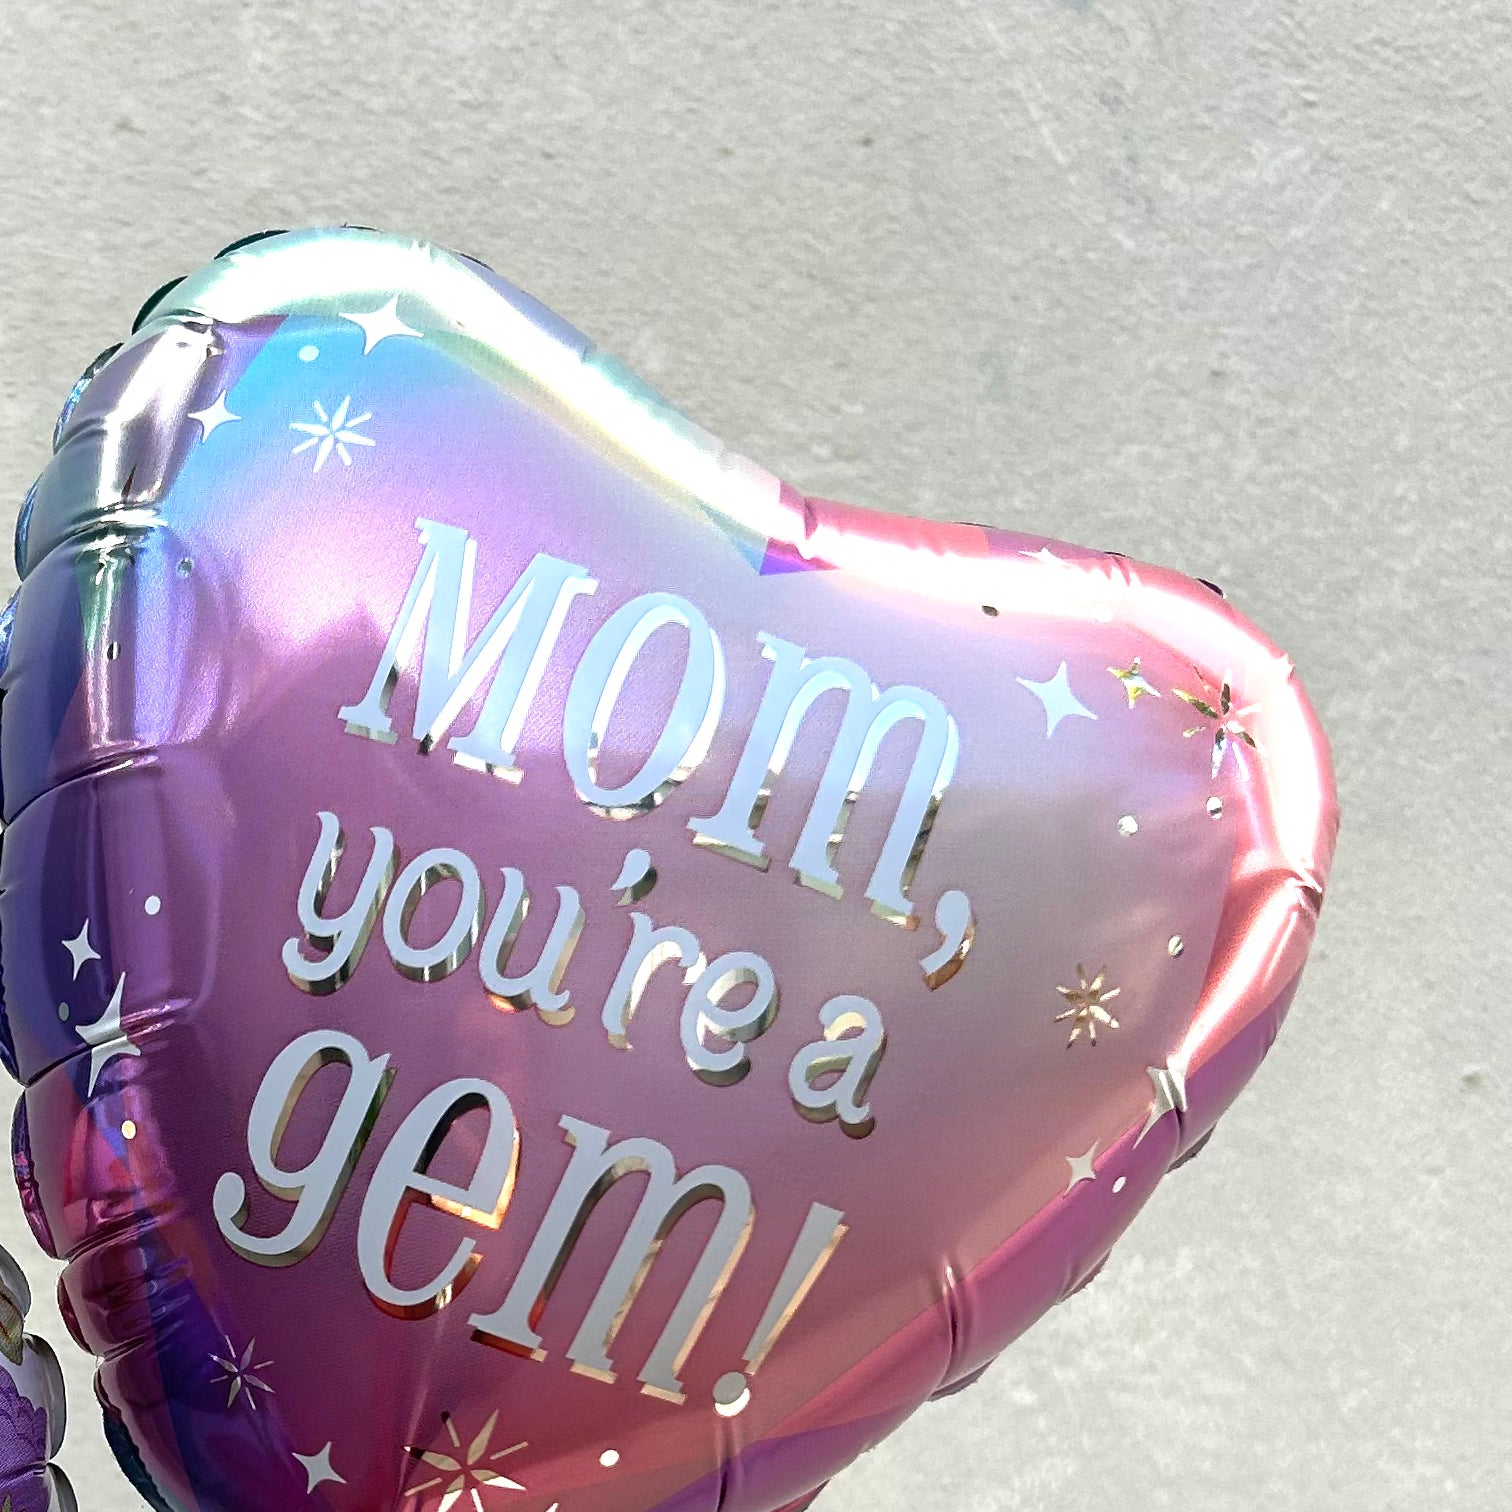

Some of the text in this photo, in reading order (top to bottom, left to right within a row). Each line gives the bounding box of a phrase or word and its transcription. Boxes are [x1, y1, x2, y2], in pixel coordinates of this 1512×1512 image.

[338, 516, 977, 991] Mom,
[282, 810, 885, 1138] you're a
[213, 1029, 849, 1417] gem!
